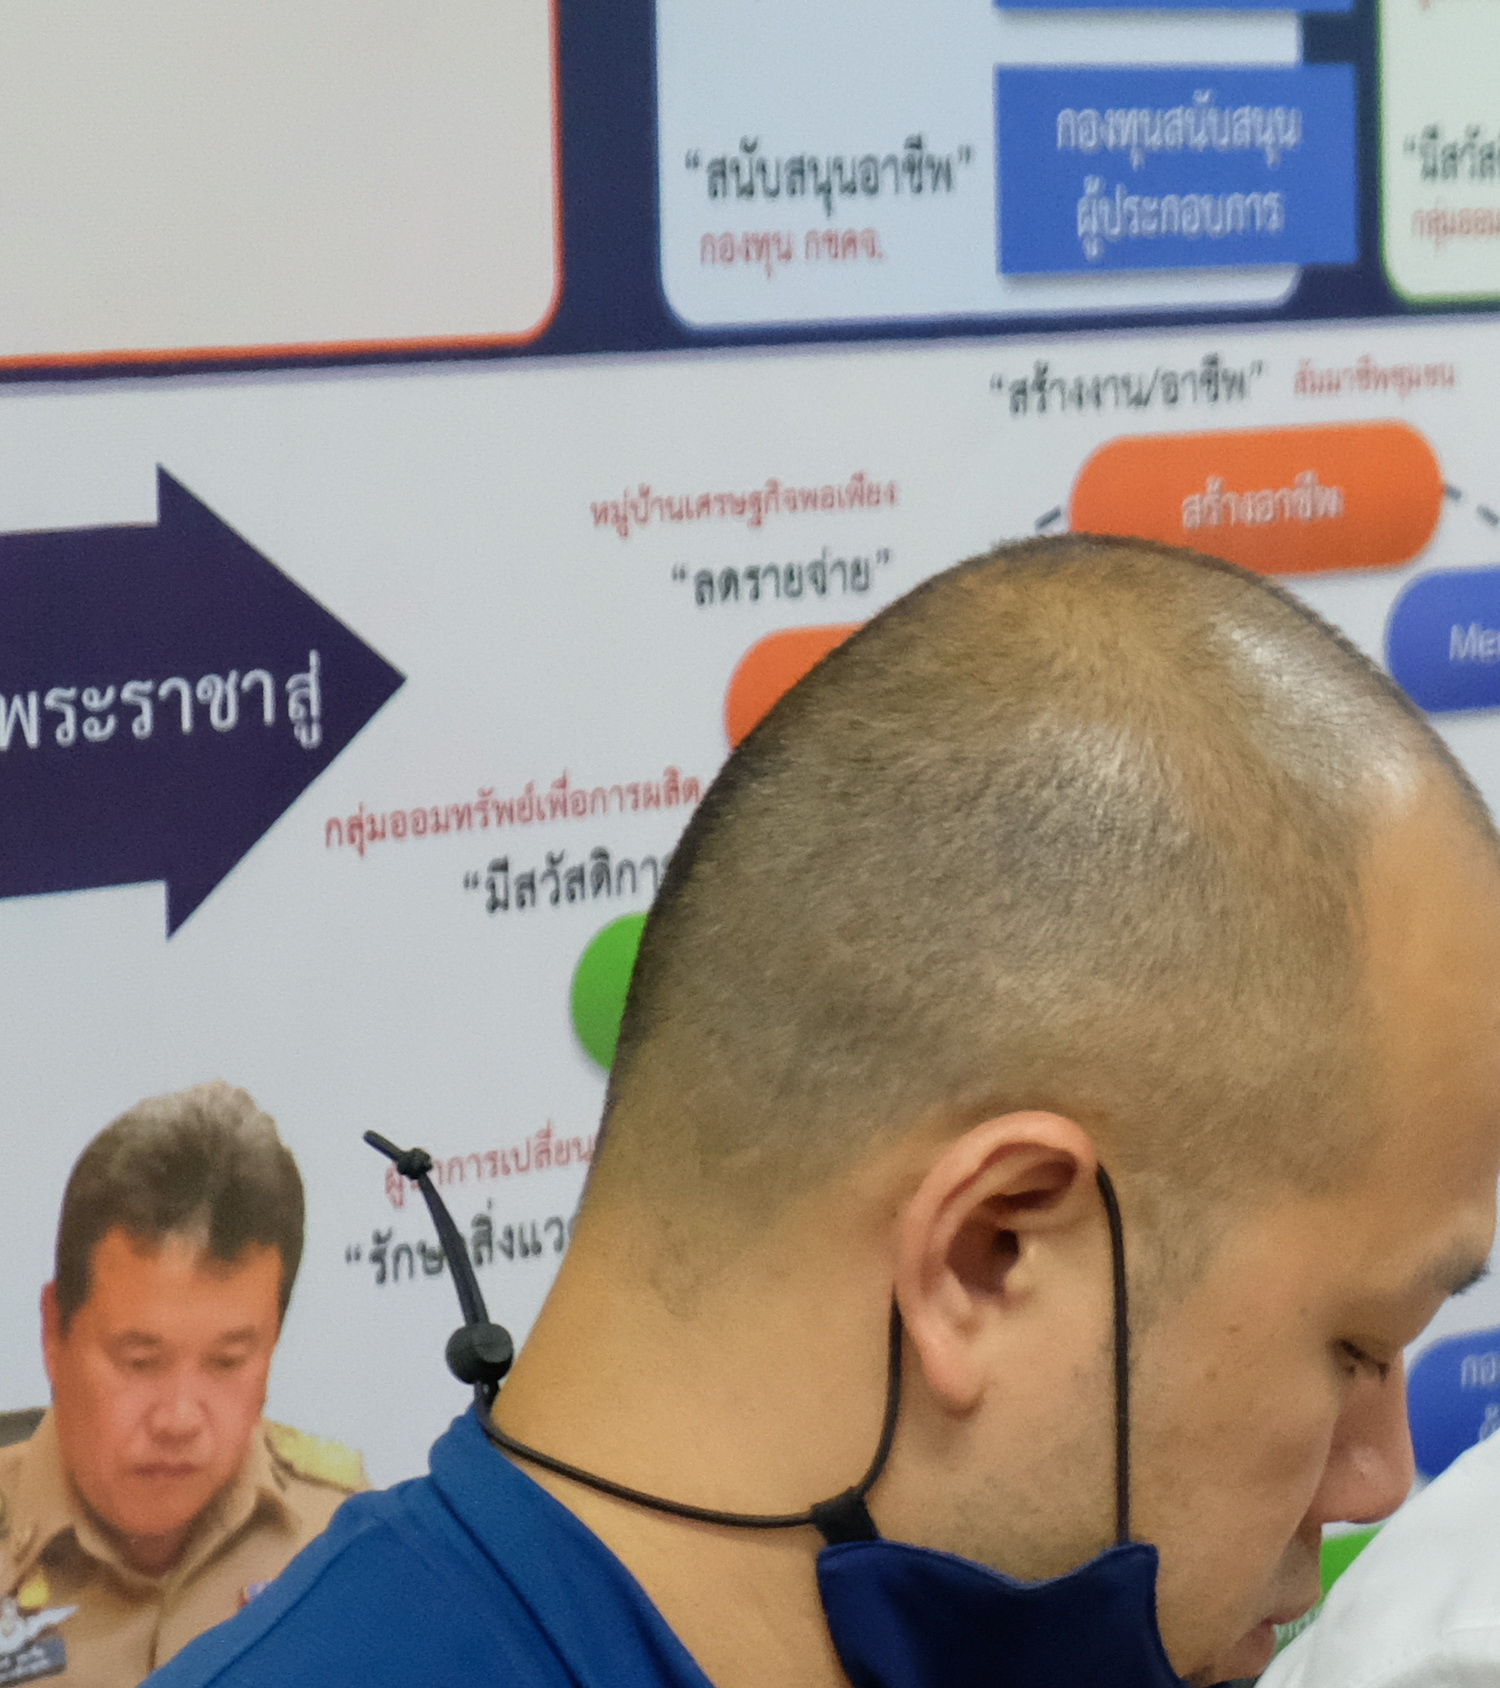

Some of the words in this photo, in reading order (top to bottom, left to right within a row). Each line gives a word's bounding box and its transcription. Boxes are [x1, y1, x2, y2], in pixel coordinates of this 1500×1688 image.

[1056, 89, 1301, 168] กองทุนสนับสนุน
[684, 132, 976, 217] “สนับสนุนอาชีพ”
[1075, 174, 1284, 260] ผู้ประกอบการ
[700, 230, 793, 279] กองทุน
[989, 352, 1264, 417] “สร้างงาน/อาชีพ”
[1181, 470, 1343, 531] สร้างอาชีพ
[671, 547, 893, 608] “ลดรายจ่าย”
[463, 846, 672, 915] “มีสวัสดิกา
[345, 1197, 574, 1286] “รักษสิ่งแว
